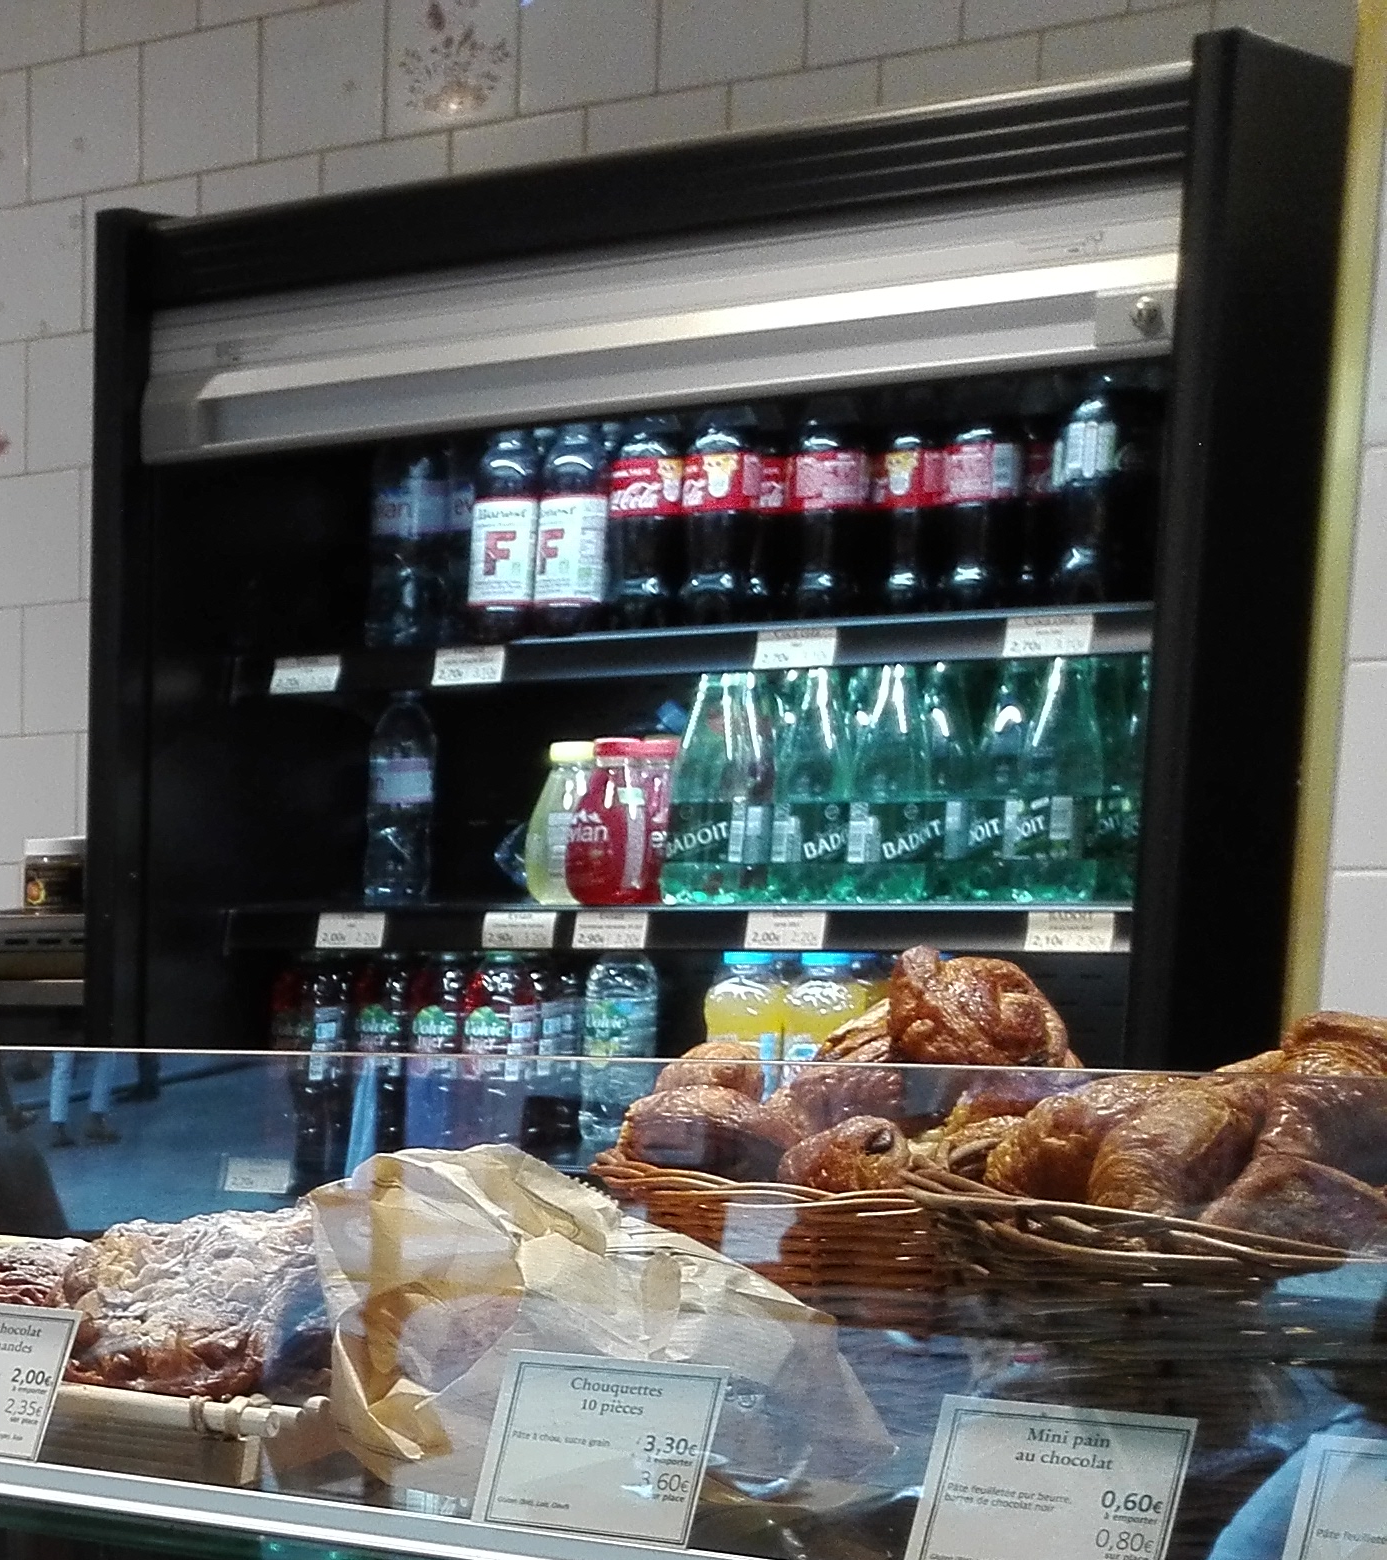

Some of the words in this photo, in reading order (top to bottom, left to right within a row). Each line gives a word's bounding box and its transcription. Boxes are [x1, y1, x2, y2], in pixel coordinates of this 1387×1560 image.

[483, 531, 517, 576] F
[10, 1367, 52, 1387] 2,00€
[570, 1376, 664, 1398] Chouquettes
[4, 1397, 43, 1418] 2,35€
[580, 1398, 598, 1411] 10
[599, 1398, 645, 1416] pièces
[643, 1434, 699, 1457] 3,30€
[1026, 1426, 1069, 1445] Mini
[1072, 1430, 1112, 1449] pain
[1015, 1450, 1036, 1462] au
[1040, 1450, 1114, 1471] chocolat
[990, 1497, 1031, 1511] chocolat
[1034, 1501, 1056, 1512] noir
[1100, 1489, 1164, 1514] 0,60€
[1112, 1512, 1159, 1526] emporter
[1094, 1527, 1155, 1554] 0,80€
